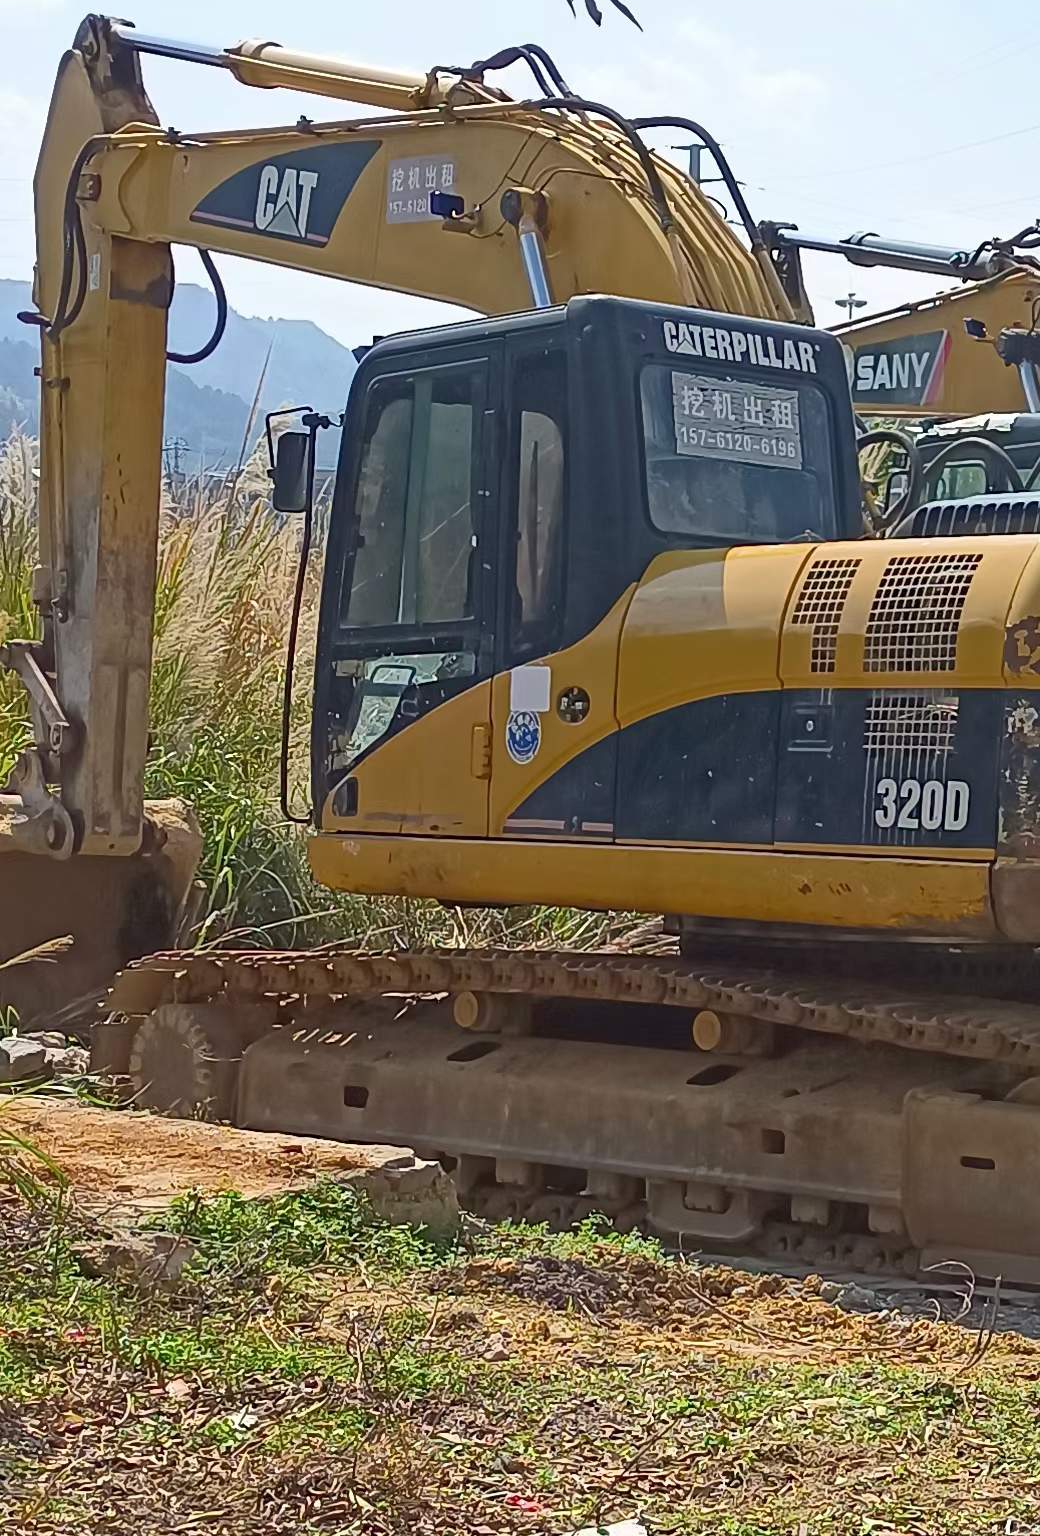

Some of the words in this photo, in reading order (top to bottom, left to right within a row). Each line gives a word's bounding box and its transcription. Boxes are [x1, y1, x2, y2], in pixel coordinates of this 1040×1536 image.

[392, 164, 454, 192] 挖机出租
[256, 165, 319, 238] CAT
[663, 320, 817, 374] CATERPILLAR
[856, 351, 930, 391] SANY
[681, 384, 794, 429] 挖机出租
[680, 426, 796, 458] 157-6120-6196
[874, 778, 971, 832] 320D
